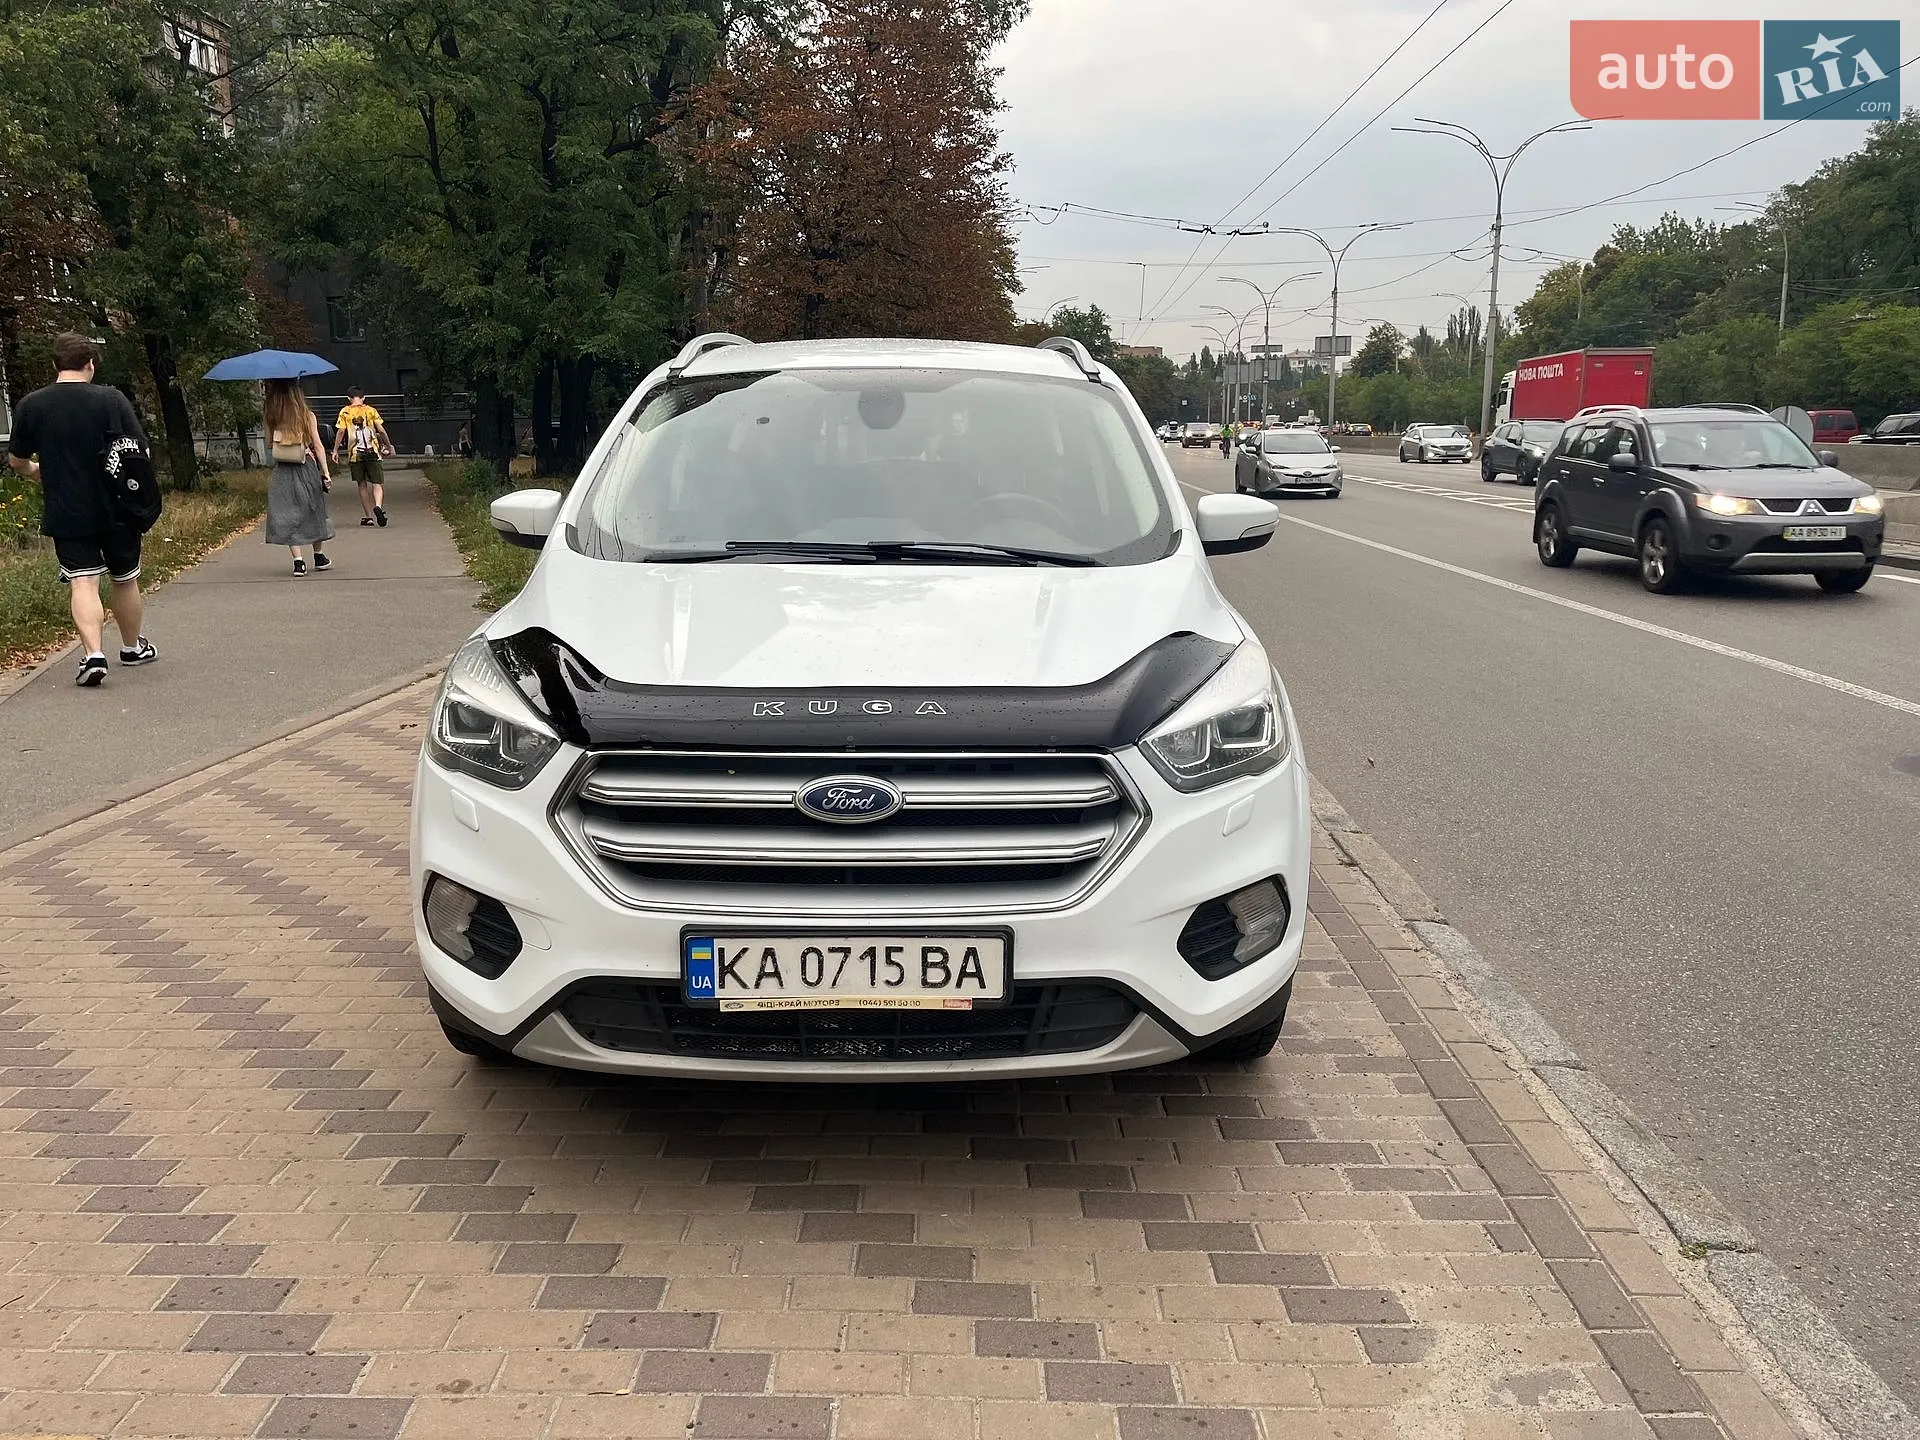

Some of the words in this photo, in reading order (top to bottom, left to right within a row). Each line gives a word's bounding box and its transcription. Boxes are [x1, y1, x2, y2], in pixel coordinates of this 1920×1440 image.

[1519, 367, 1537, 381] НОВА
[1537, 363, 1564, 379] ПОШТА
[752, 700, 947, 716] KUGA
[821, 787, 876, 811] Ford
[718, 946, 785, 990] KA
[800, 946, 905, 990] 0715
[920, 946, 987, 990] BA
[692, 976, 712, 989] UA
